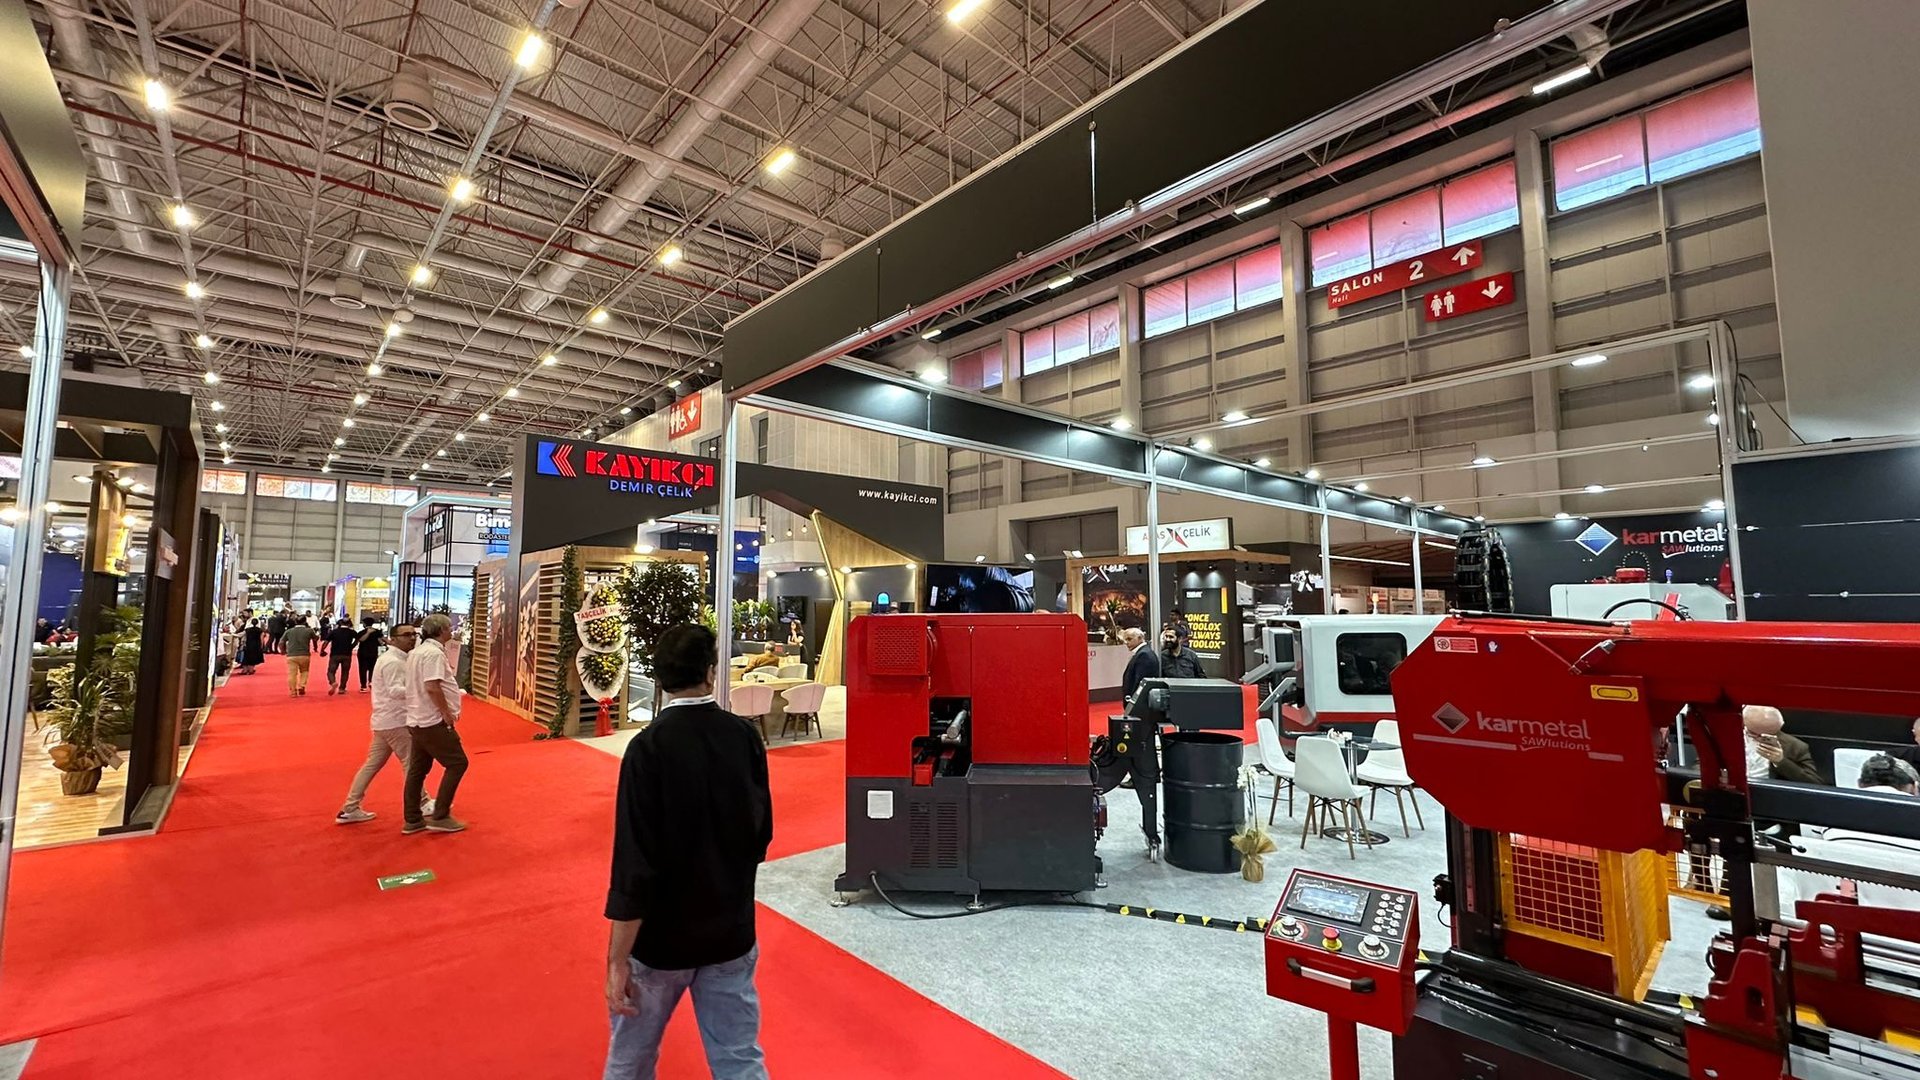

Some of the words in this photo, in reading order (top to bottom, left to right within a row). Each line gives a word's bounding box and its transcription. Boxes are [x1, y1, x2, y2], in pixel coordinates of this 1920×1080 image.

[1331, 272, 1383, 296] SALON
[1409, 260, 1424, 281] 2
[1332, 295, 1349, 304] Hall
[585, 450, 714, 491] KAYIKÇI
[858, 489, 937, 504] www.kayikci.com
[1142, 531, 1166, 541] AS
[1183, 525, 1211, 539] ÇELİK
[1622, 522, 1726, 545] karmetal
[1661, 544, 1724, 554] SAWlutions
[1188, 622, 1222, 631] TOOLOX
[1189, 631, 1221, 640] LWAYS
[1476, 711, 1591, 740] karmetal
[1521, 736, 1591, 752] SAWlutions
